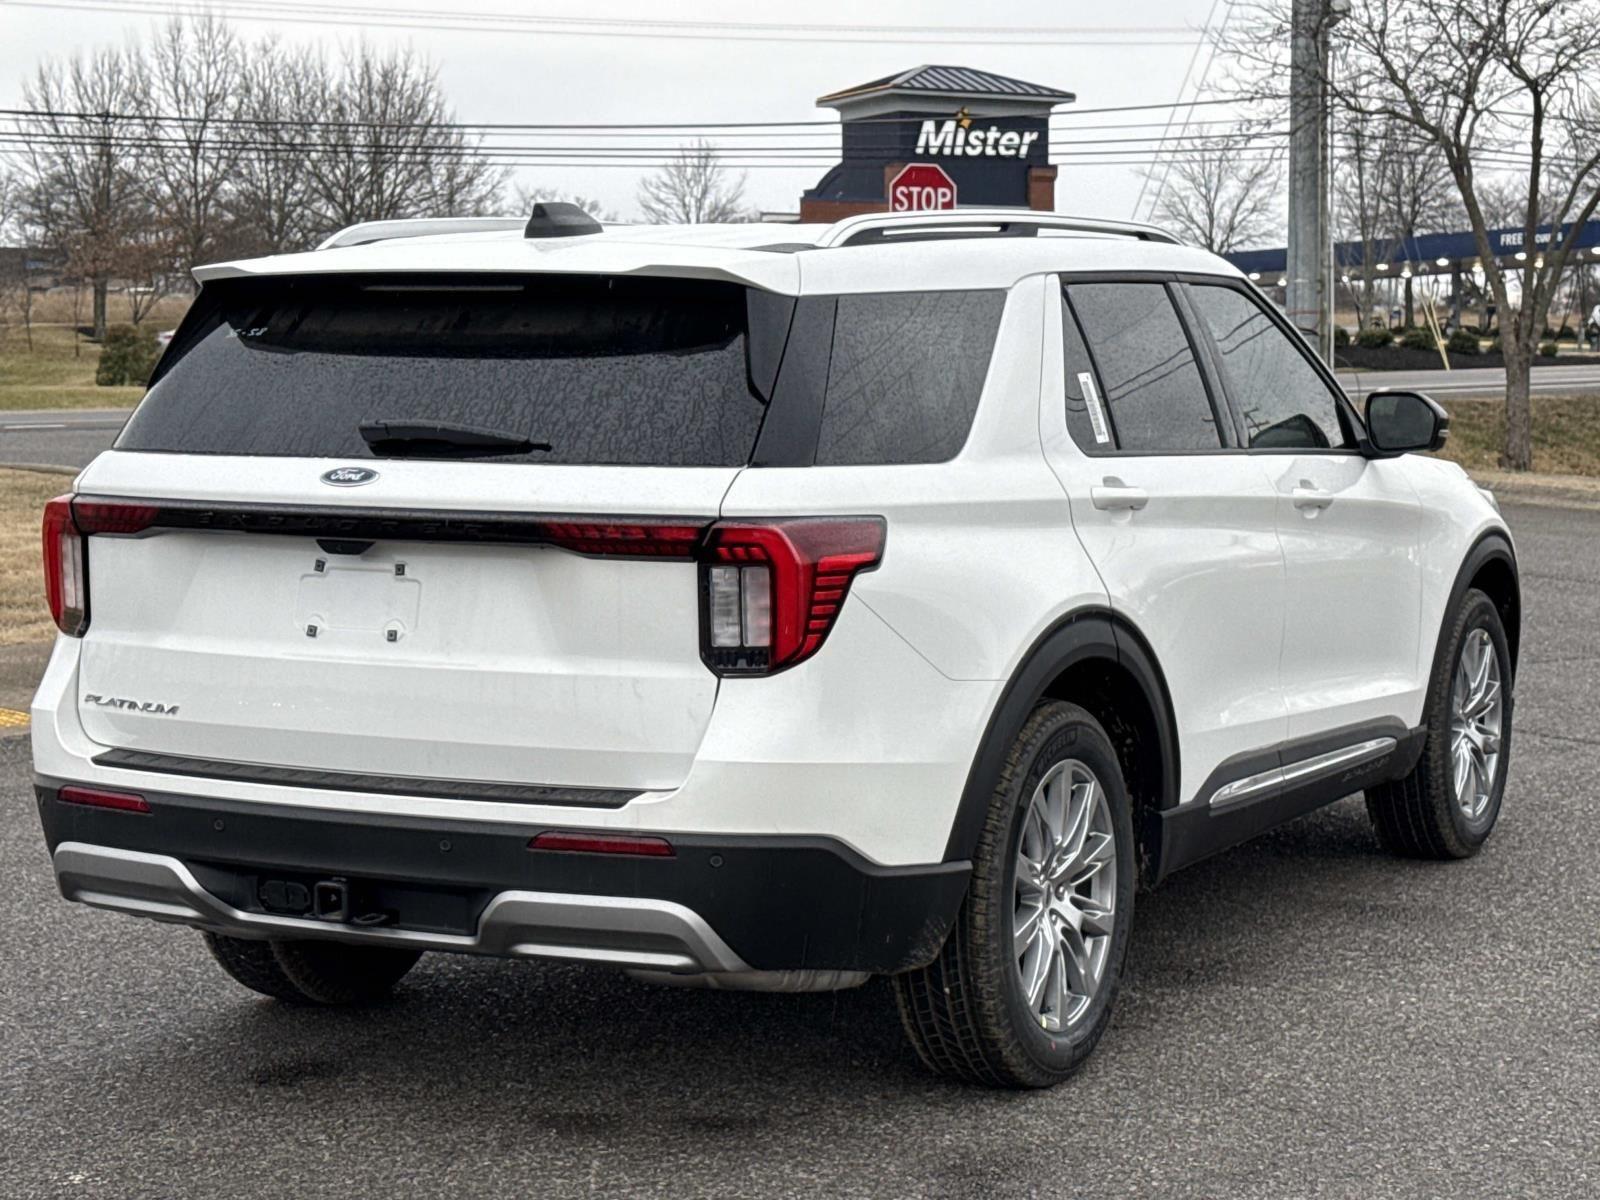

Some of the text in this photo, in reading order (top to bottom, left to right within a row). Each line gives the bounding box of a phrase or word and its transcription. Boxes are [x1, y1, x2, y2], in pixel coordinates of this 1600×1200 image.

[915, 119, 1039, 158] Mister
[895, 186, 951, 211] STOP
[1500, 232, 1523, 246] FREE
[84, 694, 180, 715] PLATINUM
